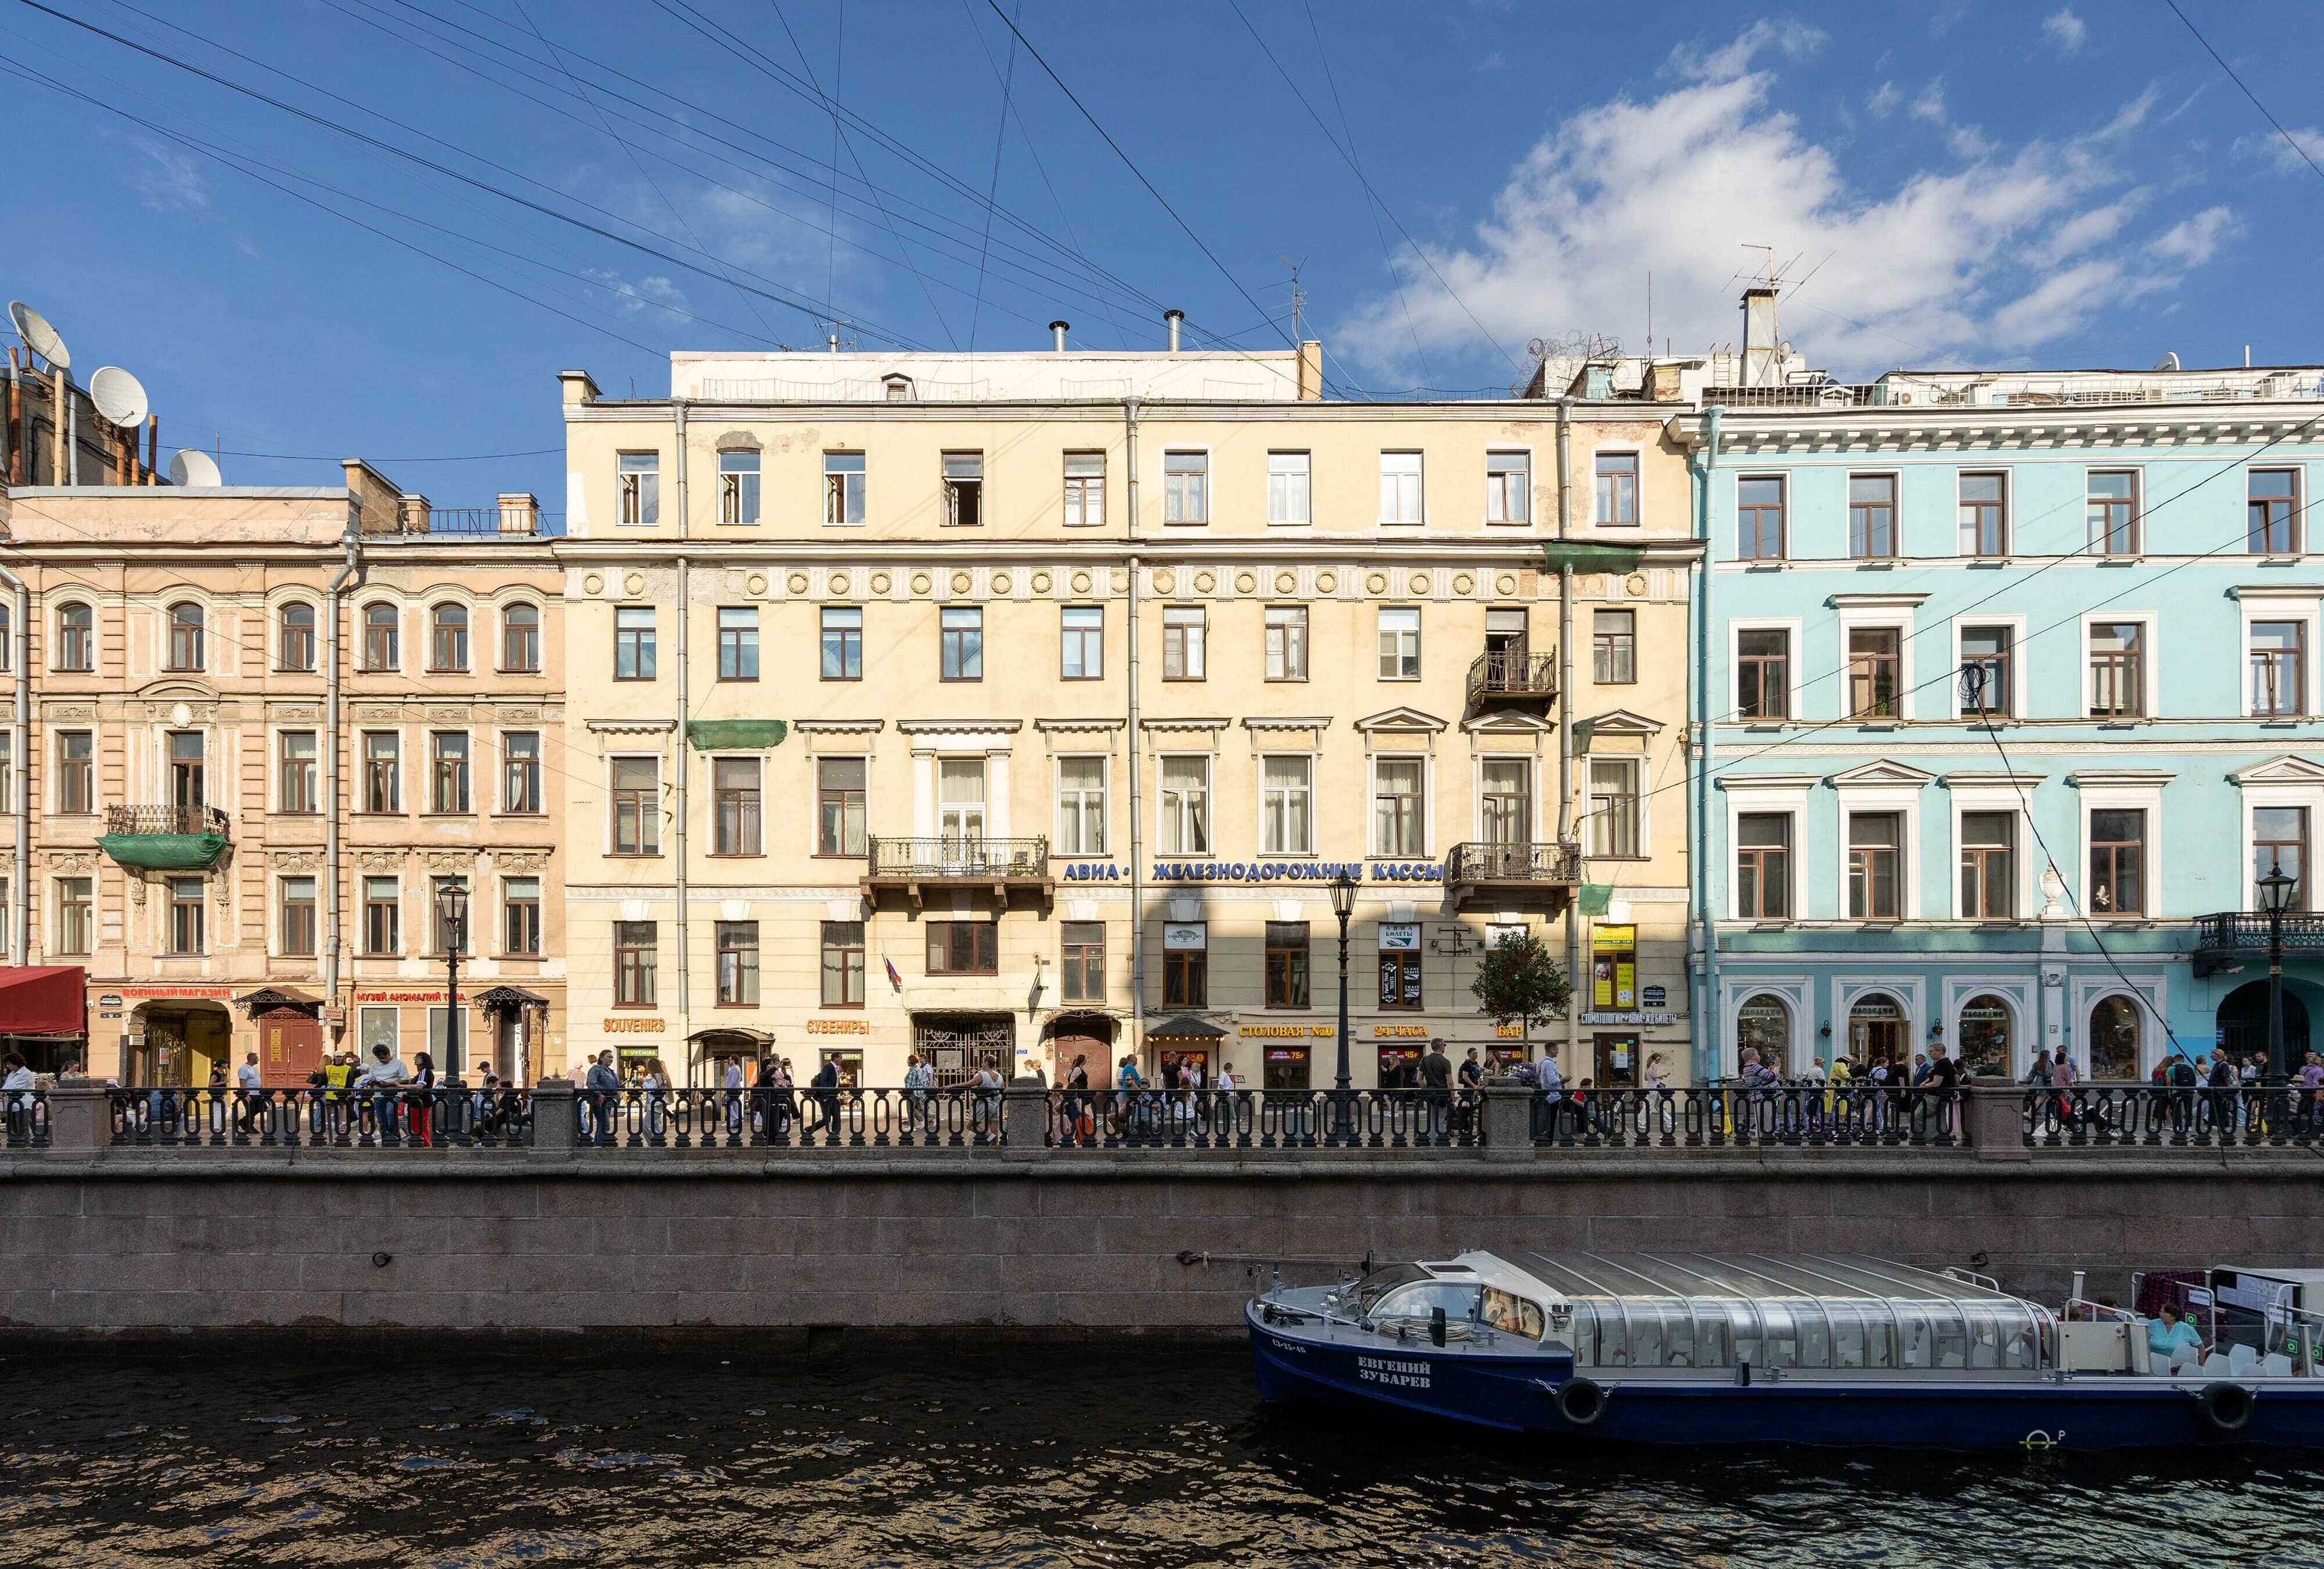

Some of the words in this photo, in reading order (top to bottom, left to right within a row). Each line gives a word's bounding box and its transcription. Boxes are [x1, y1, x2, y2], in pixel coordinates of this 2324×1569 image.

[1064, 864, 1119, 880] АВИА
[1152, 863, 1362, 881] ЖЕЛЕЗНОДОРОЖНЫЕ
[1372, 863, 1443, 881] КАССЫ
[122, 988, 178, 998] ВОЕННЫЙ
[179, 988, 231, 997] МАГАЗИН
[357, 992, 387, 1001] МУЗЕЙ
[390, 992, 441, 1001] АНОМАЛИЙ
[1581, 1013, 1623, 1024] СТОМАТОЛОГИЯ
[1656, 1014, 1676, 1024] БИЛЕТЫ
[603, 1018, 665, 1032] SOUVENIRS
[807, 1019, 869, 1034] СУВЕНИРЫ
[1374, 1026, 1390, 1036] 24
[1394, 1025, 1428, 1036] ЧАСА
[1497, 1025, 1523, 1037] БАР
[1239, 1026, 1304, 1037] СТОЛОВАЯ
[1358, 1357, 1431, 1375] ЕВГЕНИЙ
[1360, 1369, 1430, 1388] ЗУБАРЕВ
